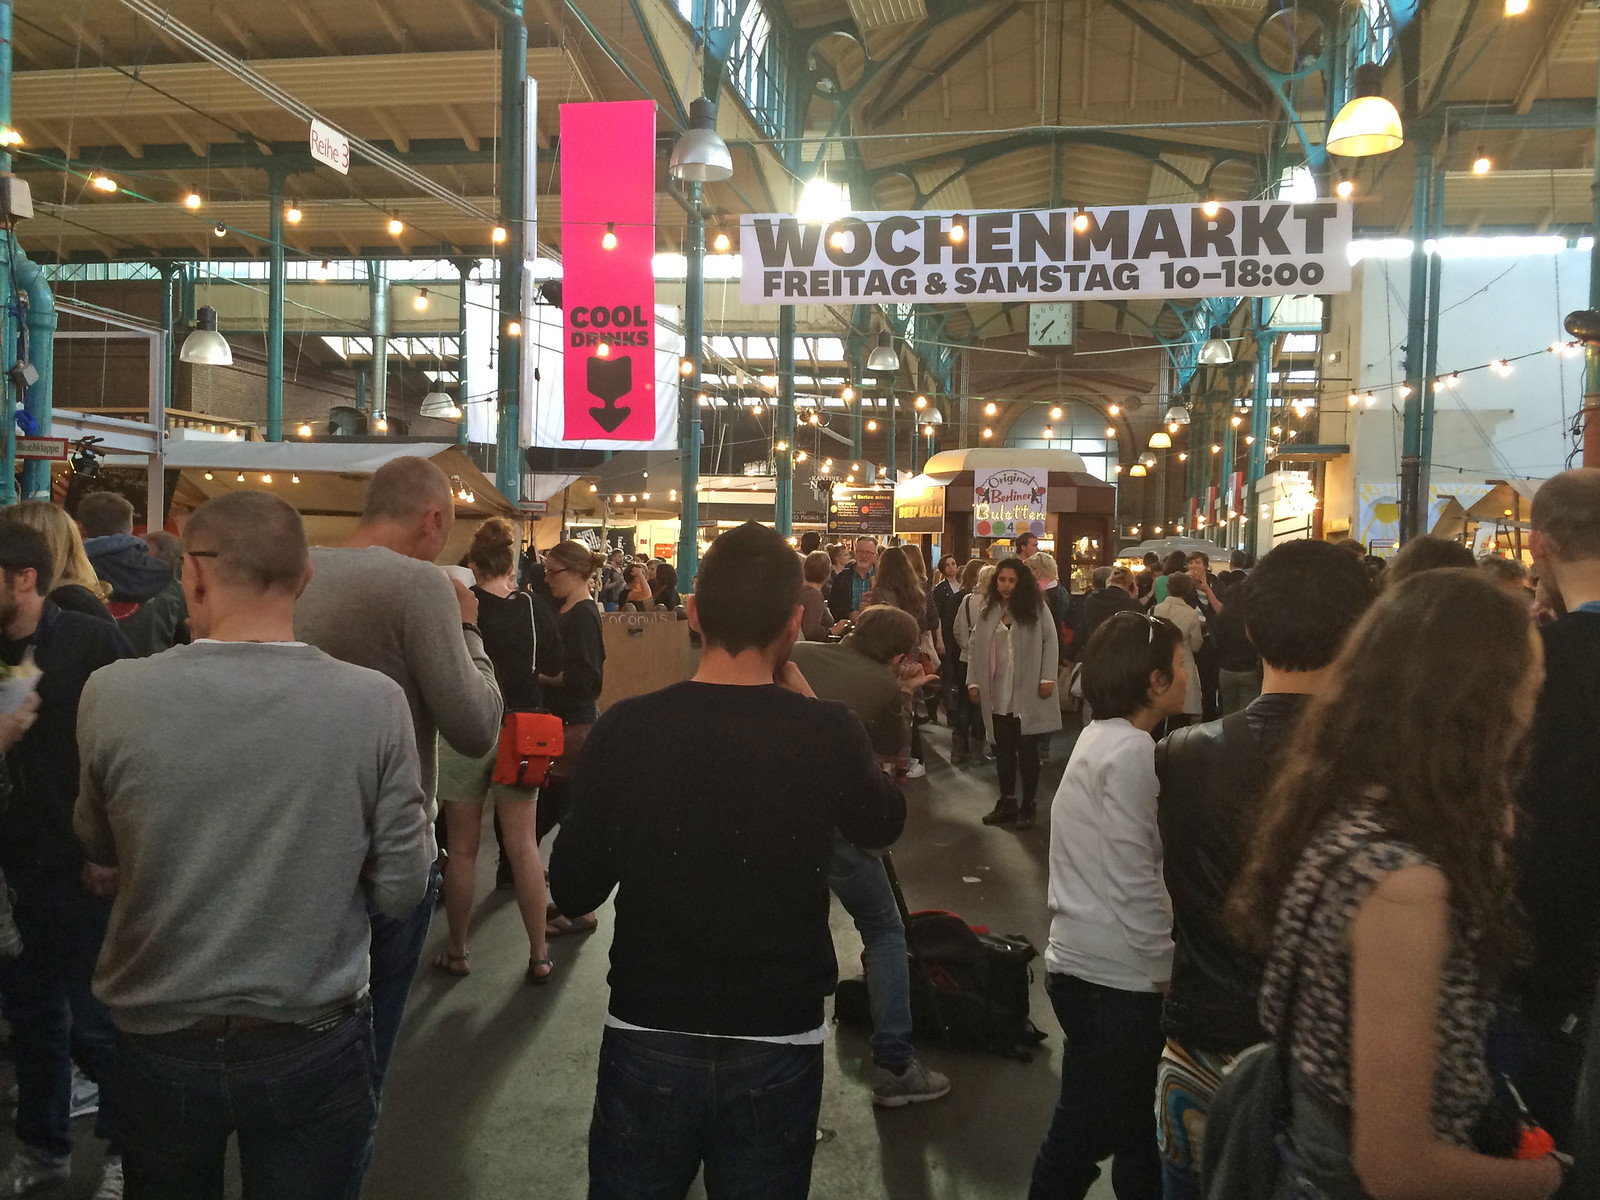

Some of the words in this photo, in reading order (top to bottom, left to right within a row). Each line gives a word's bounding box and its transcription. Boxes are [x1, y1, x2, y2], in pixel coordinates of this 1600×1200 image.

[311, 129, 338, 163] Reihe
[342, 143, 349, 168] 3
[753, 203, 1338, 268] WOCHENMARKT
[763, 268, 917, 298] FREITAG
[924, 272, 947, 295] &
[954, 262, 1140, 295] SAMSTAG
[570, 305, 648, 329] COOL
[571, 331, 649, 348] DRINKS
[988, 473, 1036, 489] Original
[991, 489, 1032, 504] Berliner
[972, 501, 1045, 521] Buletten
[1007, 522, 1015, 532] 4
